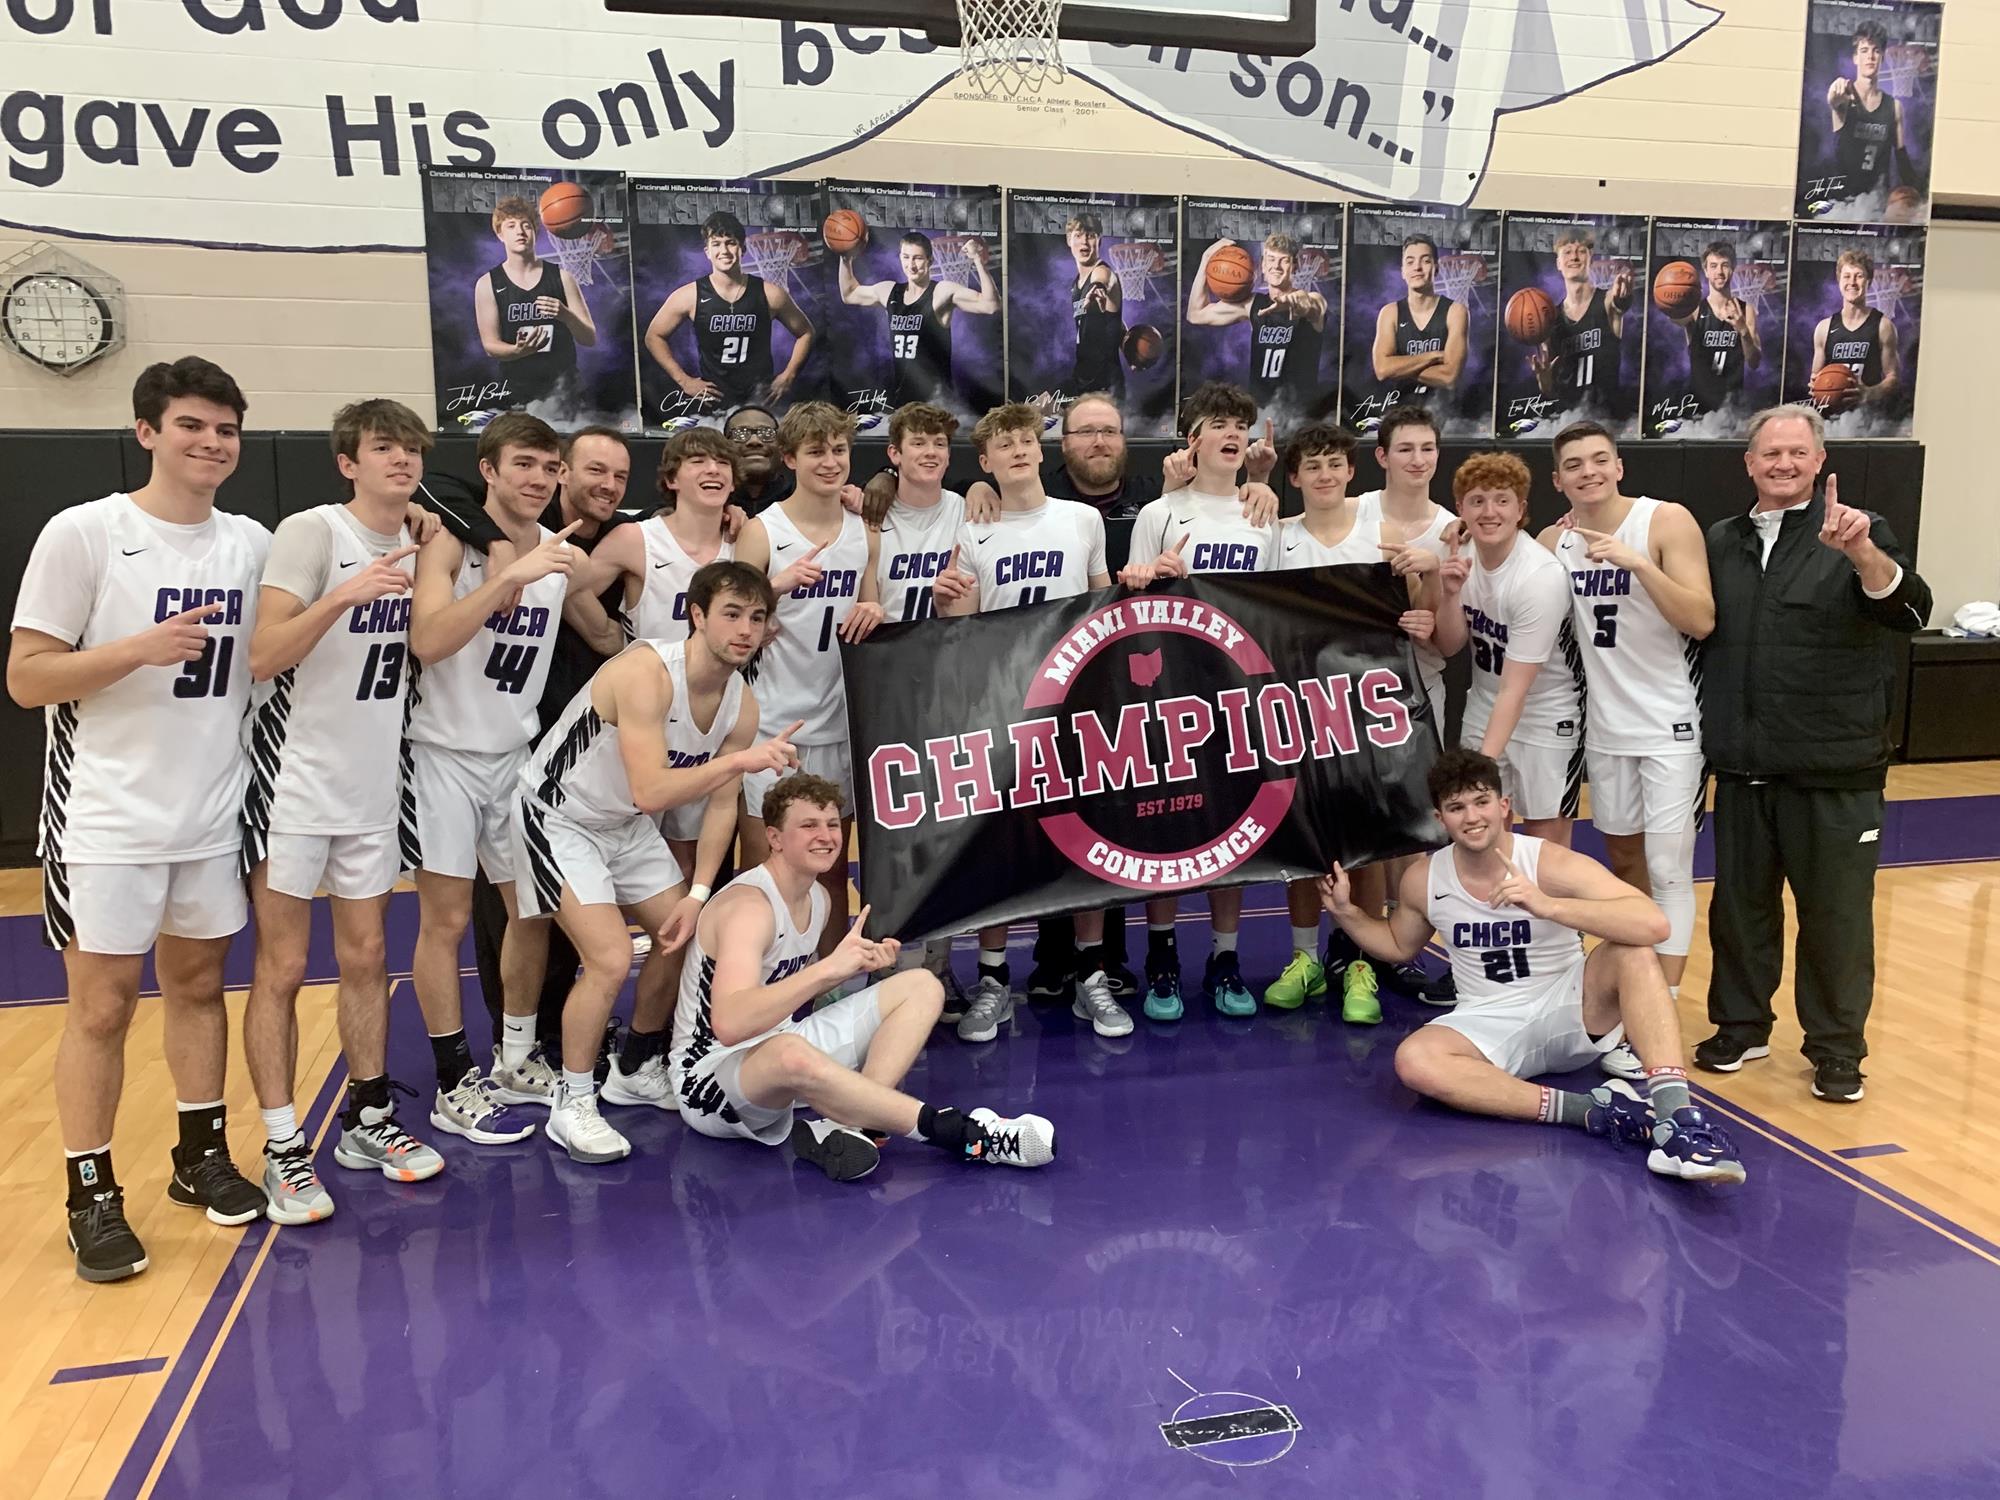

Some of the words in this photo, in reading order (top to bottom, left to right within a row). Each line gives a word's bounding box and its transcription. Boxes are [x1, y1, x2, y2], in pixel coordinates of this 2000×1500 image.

[1046, 98, 1071, 106] Athletic
[1074, 99, 1106, 108] Boosters
[0, 89, 282, 188] gave
[325, 94, 496, 176] His
[541, 47, 735, 161] only
[1861, 144, 1877, 170] 3
[429, 170, 466, 178] Cincinnati
[518, 174, 552, 182] Academy
[719, 186, 750, 194] Academy
[906, 189, 936, 198] Academy
[1013, 194, 1044, 202] Cincinnati
[1059, 196, 1088, 204] Christian
[1088, 197, 1116, 206] Academy
[1259, 204, 1284, 212] Academy
[26, 285, 38, 294] 11
[44, 280, 57, 288] 12
[66, 286, 72, 294] 1
[14, 298, 26, 306] 10
[80, 298, 90, 308] 2
[508, 302, 555, 322] CHC
[15, 316, 22, 324] 9
[90, 316, 98, 325] 3
[709, 314, 756, 333] CHCA
[890, 314, 923, 331] CHCA
[22, 332, 30, 340] 8
[894, 335, 919, 360] 33
[1704, 330, 1738, 347] CHCA
[38, 345, 46, 355] 7
[56, 350, 65, 358] 6
[76, 346, 84, 354] 5
[720, 337, 749, 364] 21
[1832, 342, 1870, 360] CHCA
[1261, 348, 1286, 378] 10
[1576, 354, 1594, 388] 11
[1712, 351, 1727, 376] 4
[889, 549, 953, 580] CHCA
[995, 550, 1064, 586] CHCA
[1192, 543, 1259, 571] CHCA
[1571, 568, 1632, 597] CHCA
[154, 588, 243, 625] CHCA
[349, 598, 412, 634] CHCA
[818, 606, 834, 652] 1
[1463, 604, 1508, 644] CHCA
[1594, 604, 1618, 648] 5
[1044, 606, 1127, 686] MIAMI
[1131, 600, 1244, 650] VALLEY
[173, 636, 234, 698] 31
[356, 642, 406, 701] 13
[484, 642, 540, 694] 44
[867, 667, 1413, 831] CHAMPIONS
[1136, 799, 1166, 818] EST
[1169, 793, 1204, 812] 1979
[1086, 816, 1267, 884] CONFERENCE
[1453, 920, 1532, 948] CHCA
[765, 952, 814, 985] CHC
[1480, 948, 1531, 984] 21
[1652, 1067, 1688, 1078] GRAY
